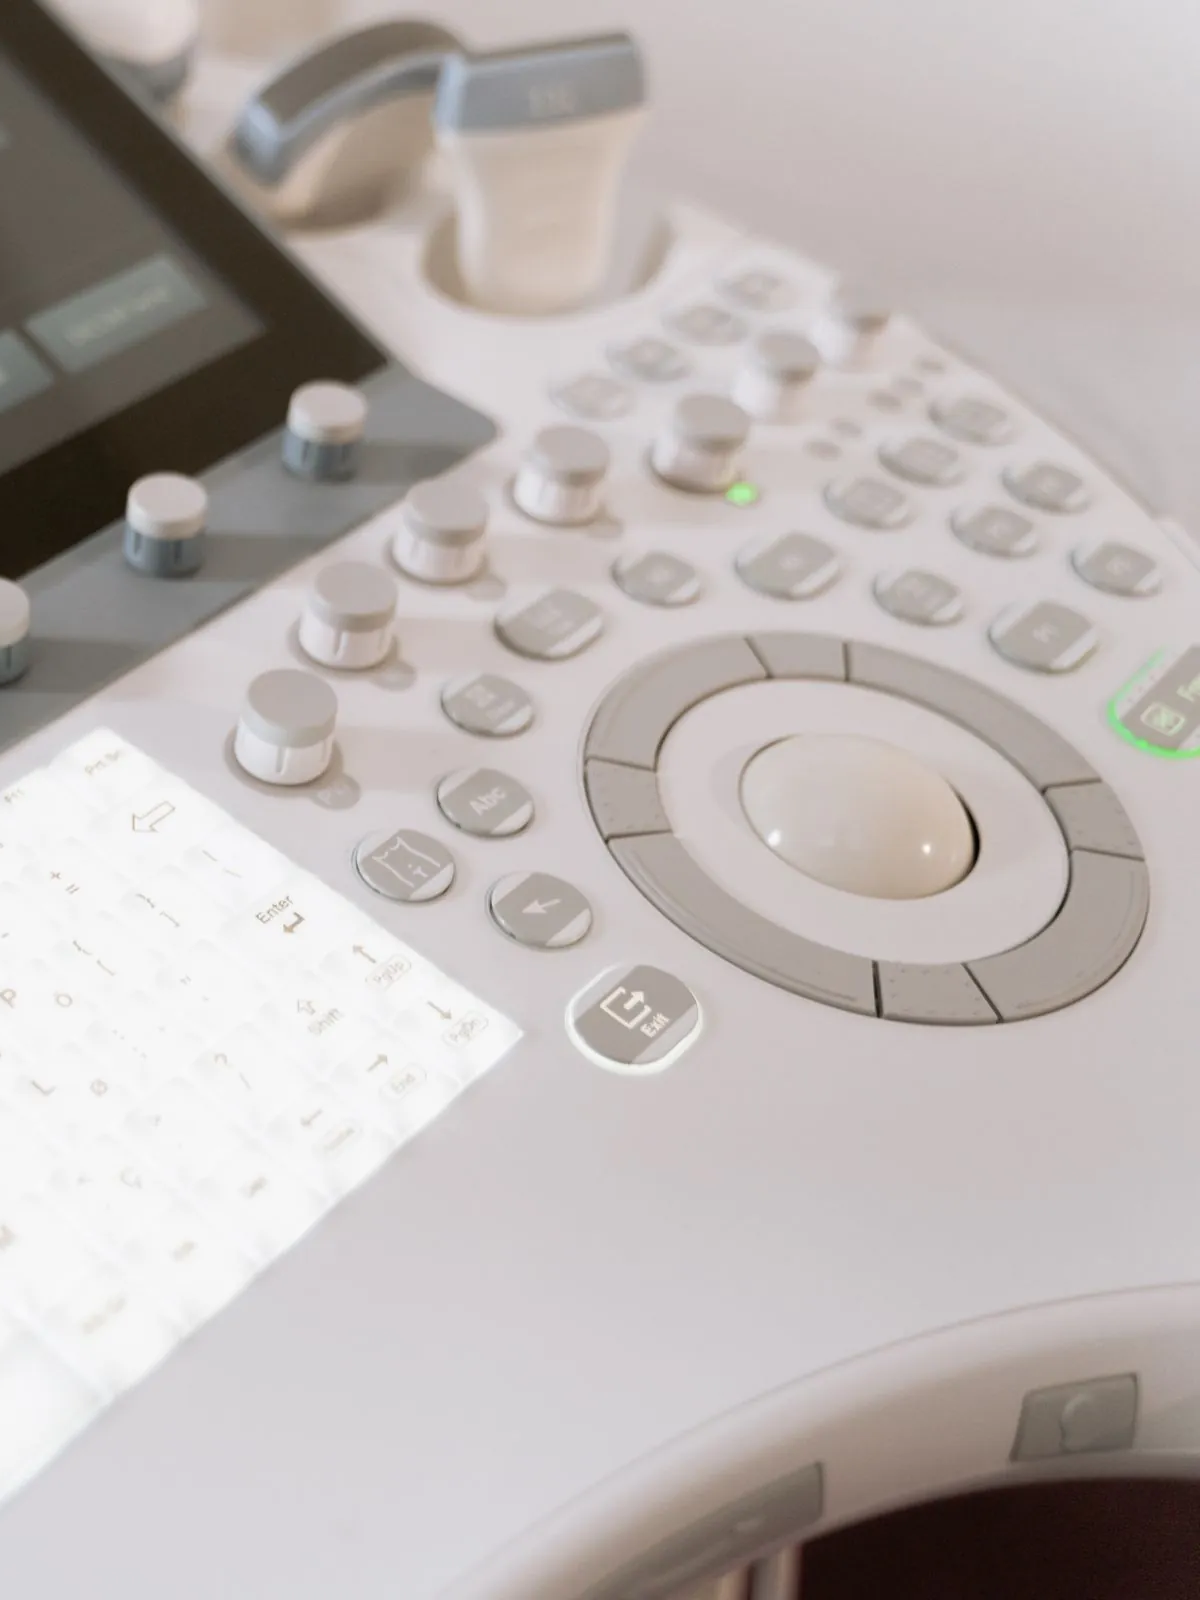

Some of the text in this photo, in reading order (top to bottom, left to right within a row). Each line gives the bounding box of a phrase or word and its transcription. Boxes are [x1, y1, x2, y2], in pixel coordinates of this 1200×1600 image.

[468, 788, 507, 816] Abc
[255, 894, 294, 925] Enter
[306, 1005, 346, 1037] Shift
[639, 1013, 671, 1039] Exit
